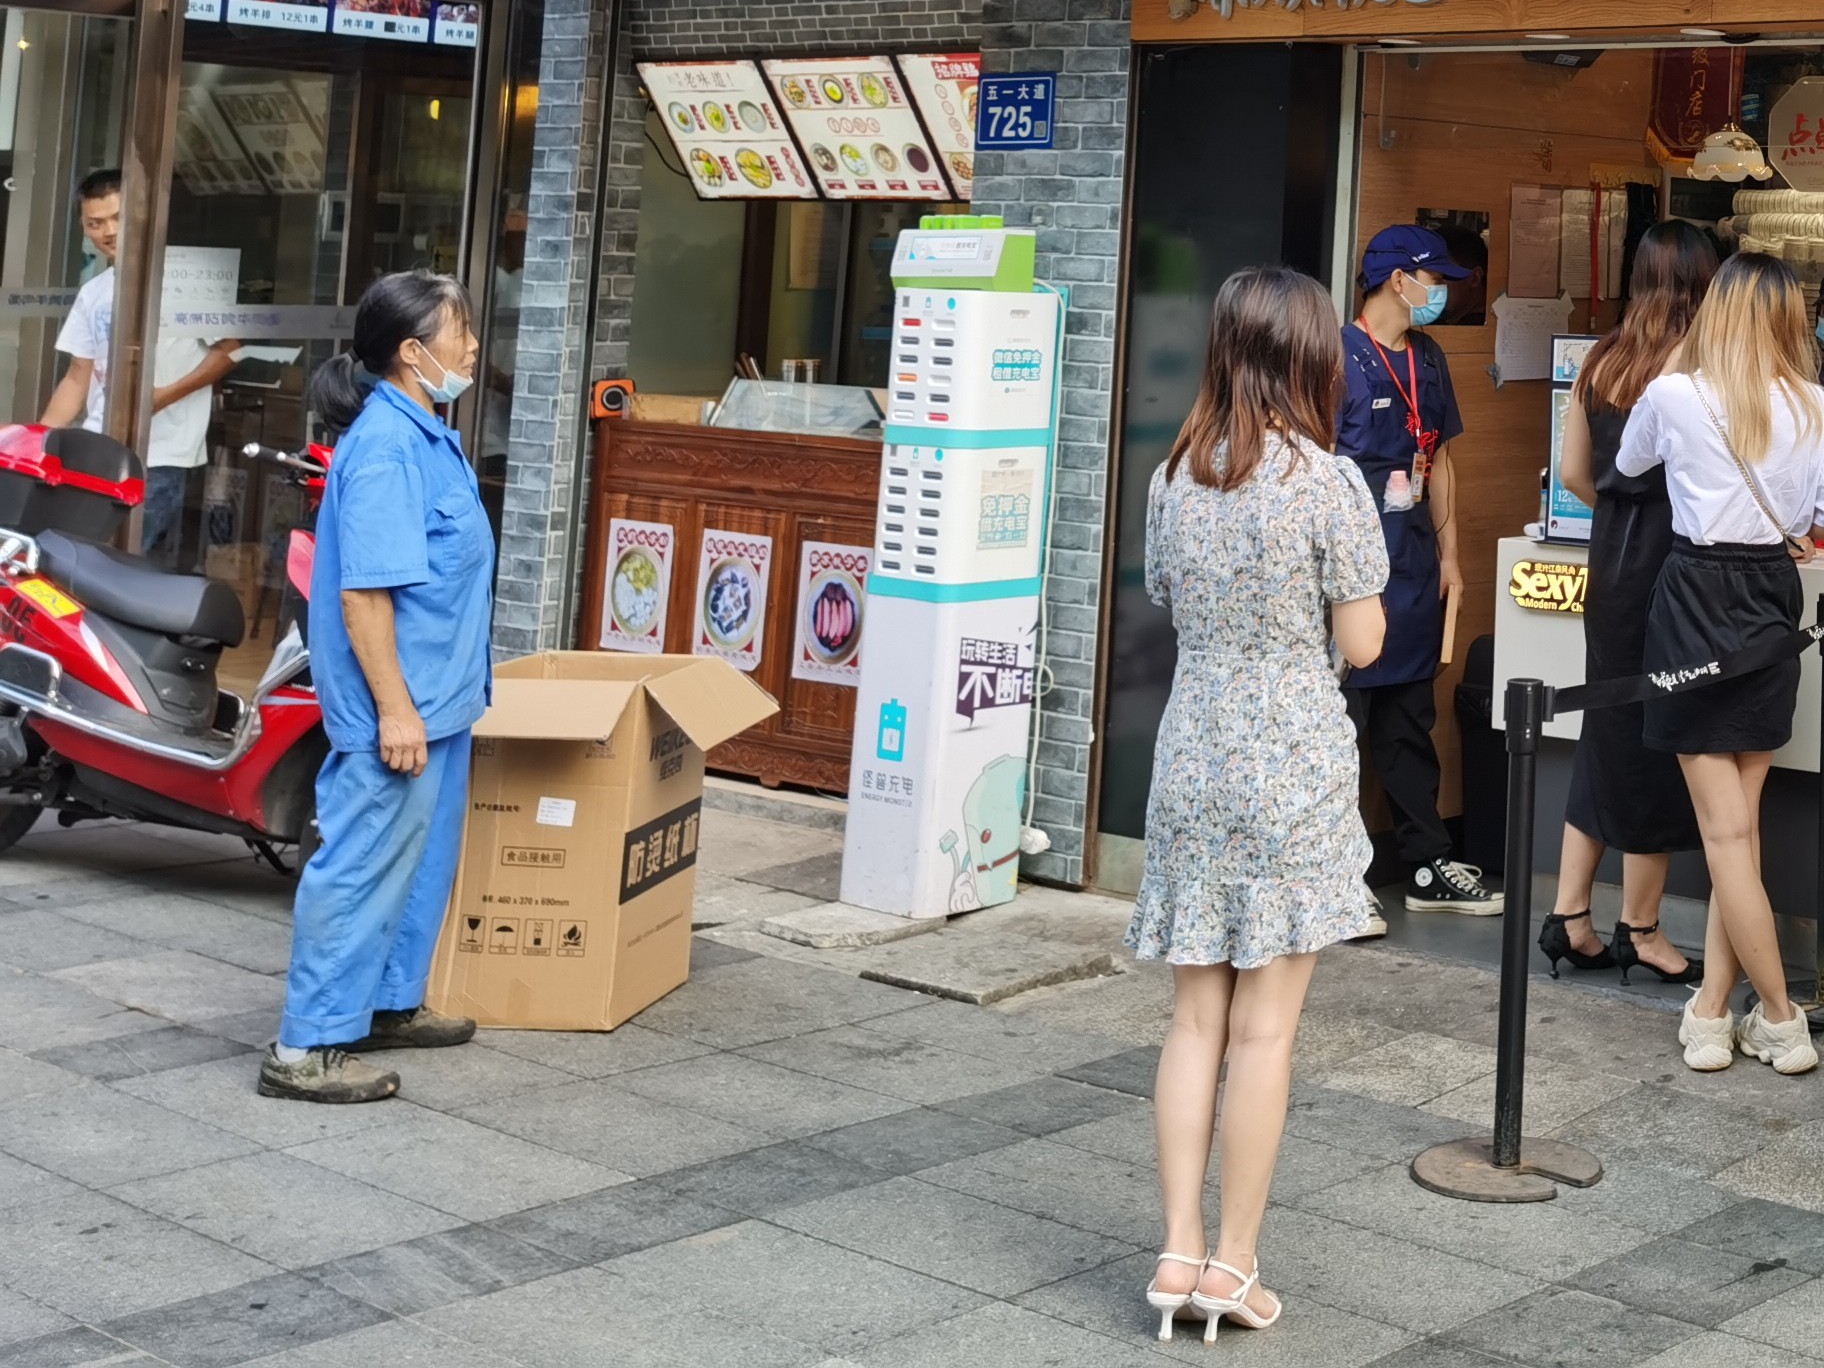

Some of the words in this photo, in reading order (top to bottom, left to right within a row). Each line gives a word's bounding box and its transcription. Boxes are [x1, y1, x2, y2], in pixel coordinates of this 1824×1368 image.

[186, 2, 214, 15] 元4串
[986, 83, 1045, 100] 五一大道
[988, 106, 1032, 138] 725
[993, 350, 1042, 364] 微信免押金
[981, 494, 1031, 516] 免押金
[1510, 561, 1588, 610] SexyT
[1525, 598, 1557, 610] Modern
[1571, 602, 1584, 612] Chi
[961, 639, 1017, 665] 玩转生活
